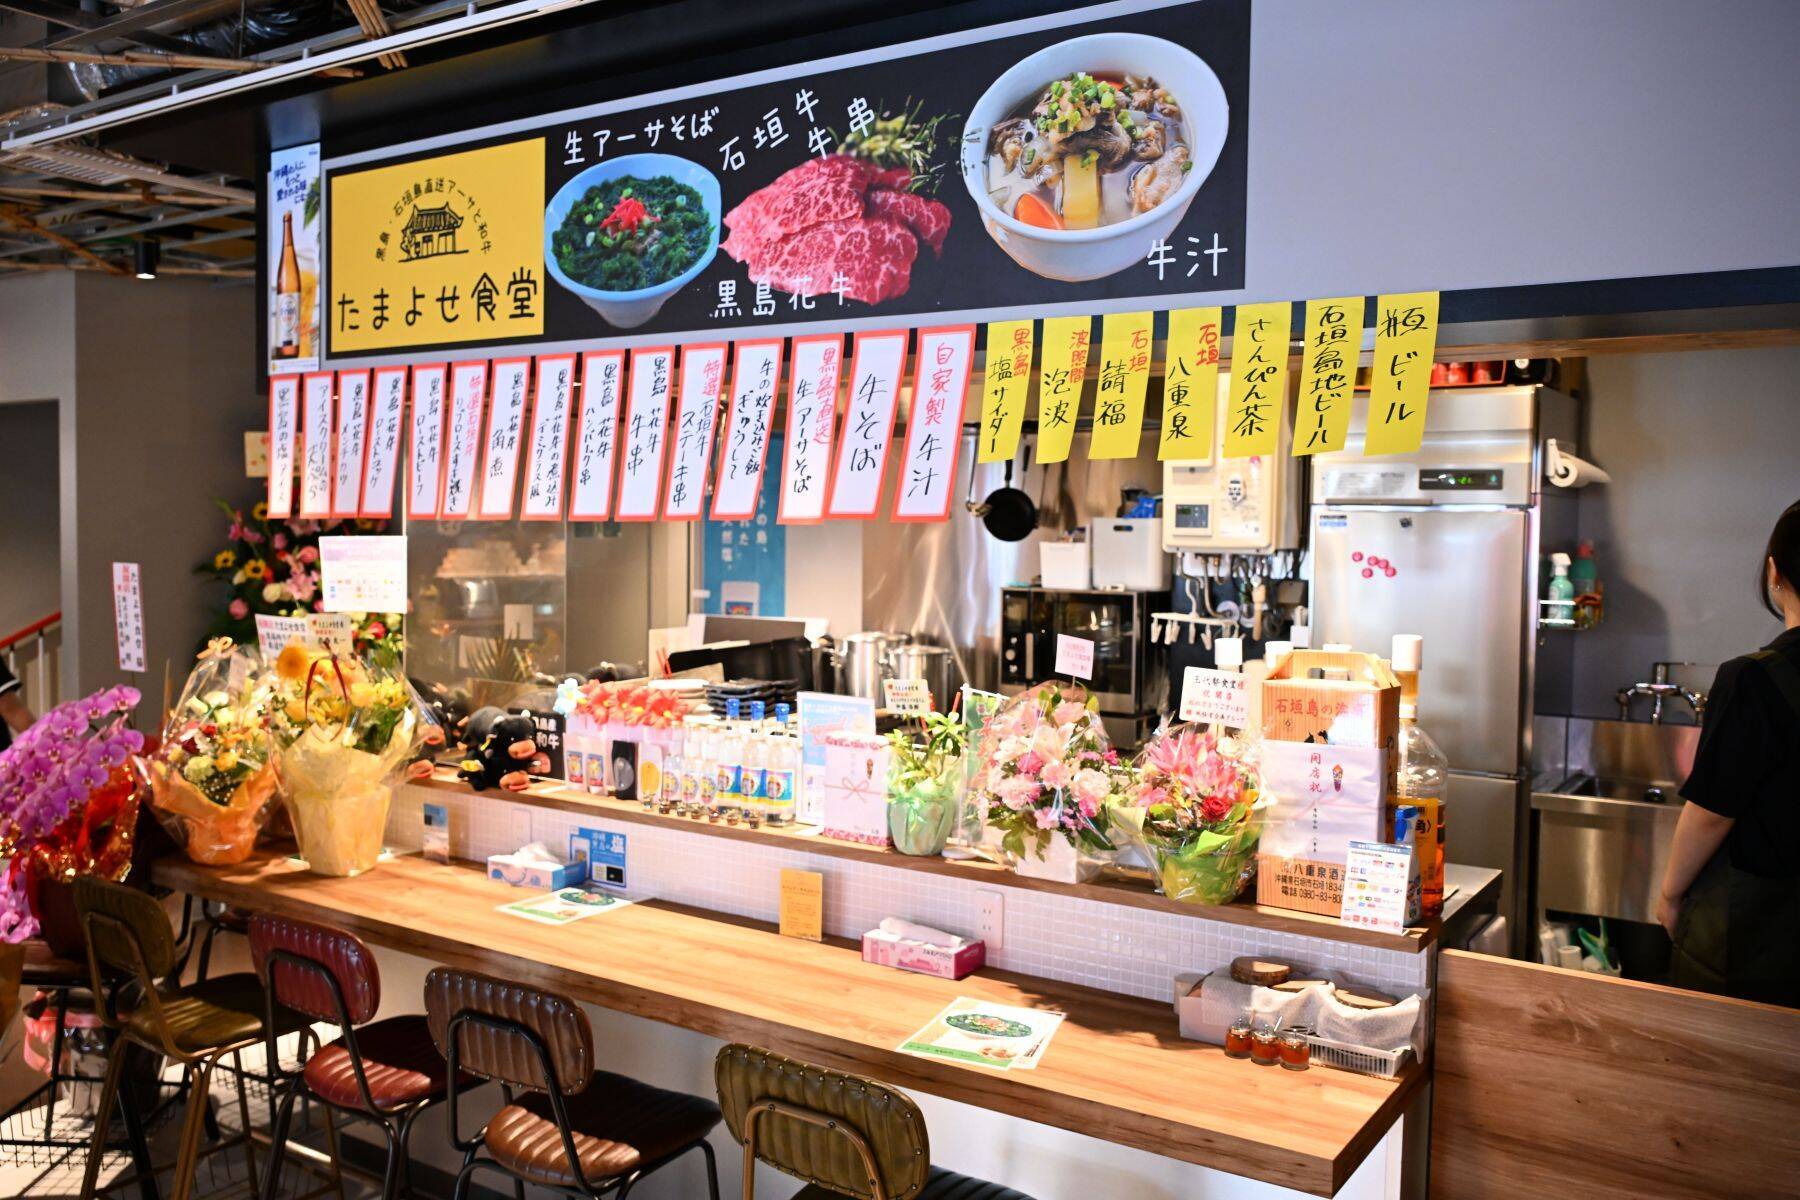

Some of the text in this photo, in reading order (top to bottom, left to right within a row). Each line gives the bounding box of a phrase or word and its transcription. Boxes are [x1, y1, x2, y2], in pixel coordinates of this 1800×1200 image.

[564, 106, 719, 165] 生アーサそば
[719, 88, 819, 171] 石垣牛
[807, 97, 875, 160] 牛串
[1147, 232, 1229, 281] 牛汁
[337, 265, 538, 333] たまよせ食堂
[713, 270, 853, 319] 黒島花牛
[1011, 327, 1032, 377] 黒島
[1129, 329, 1149, 373] 石垣
[1195, 323, 1219, 366] 石垣
[1233, 318, 1278, 437] さんぴん茶
[1306, 304, 1349, 448] 石垣島地ビール
[1380, 306, 1426, 424] 瓶ビール
[648, 355, 667, 454] 黒島花牛
[813, 346, 837, 445] 黒島直送
[850, 373, 889, 472] 牛そば
[987, 355, 1013, 454] 塩サイダー
[1043, 367, 1071, 428] 泡波
[1096, 359, 1126, 426] 請福
[1166, 356, 1194, 441] 八重泉
[673, 410, 696, 508] ステーキ串
[794, 377, 815, 494] 生アーサそば
[1309, 752, 1322, 793] 開店祝
